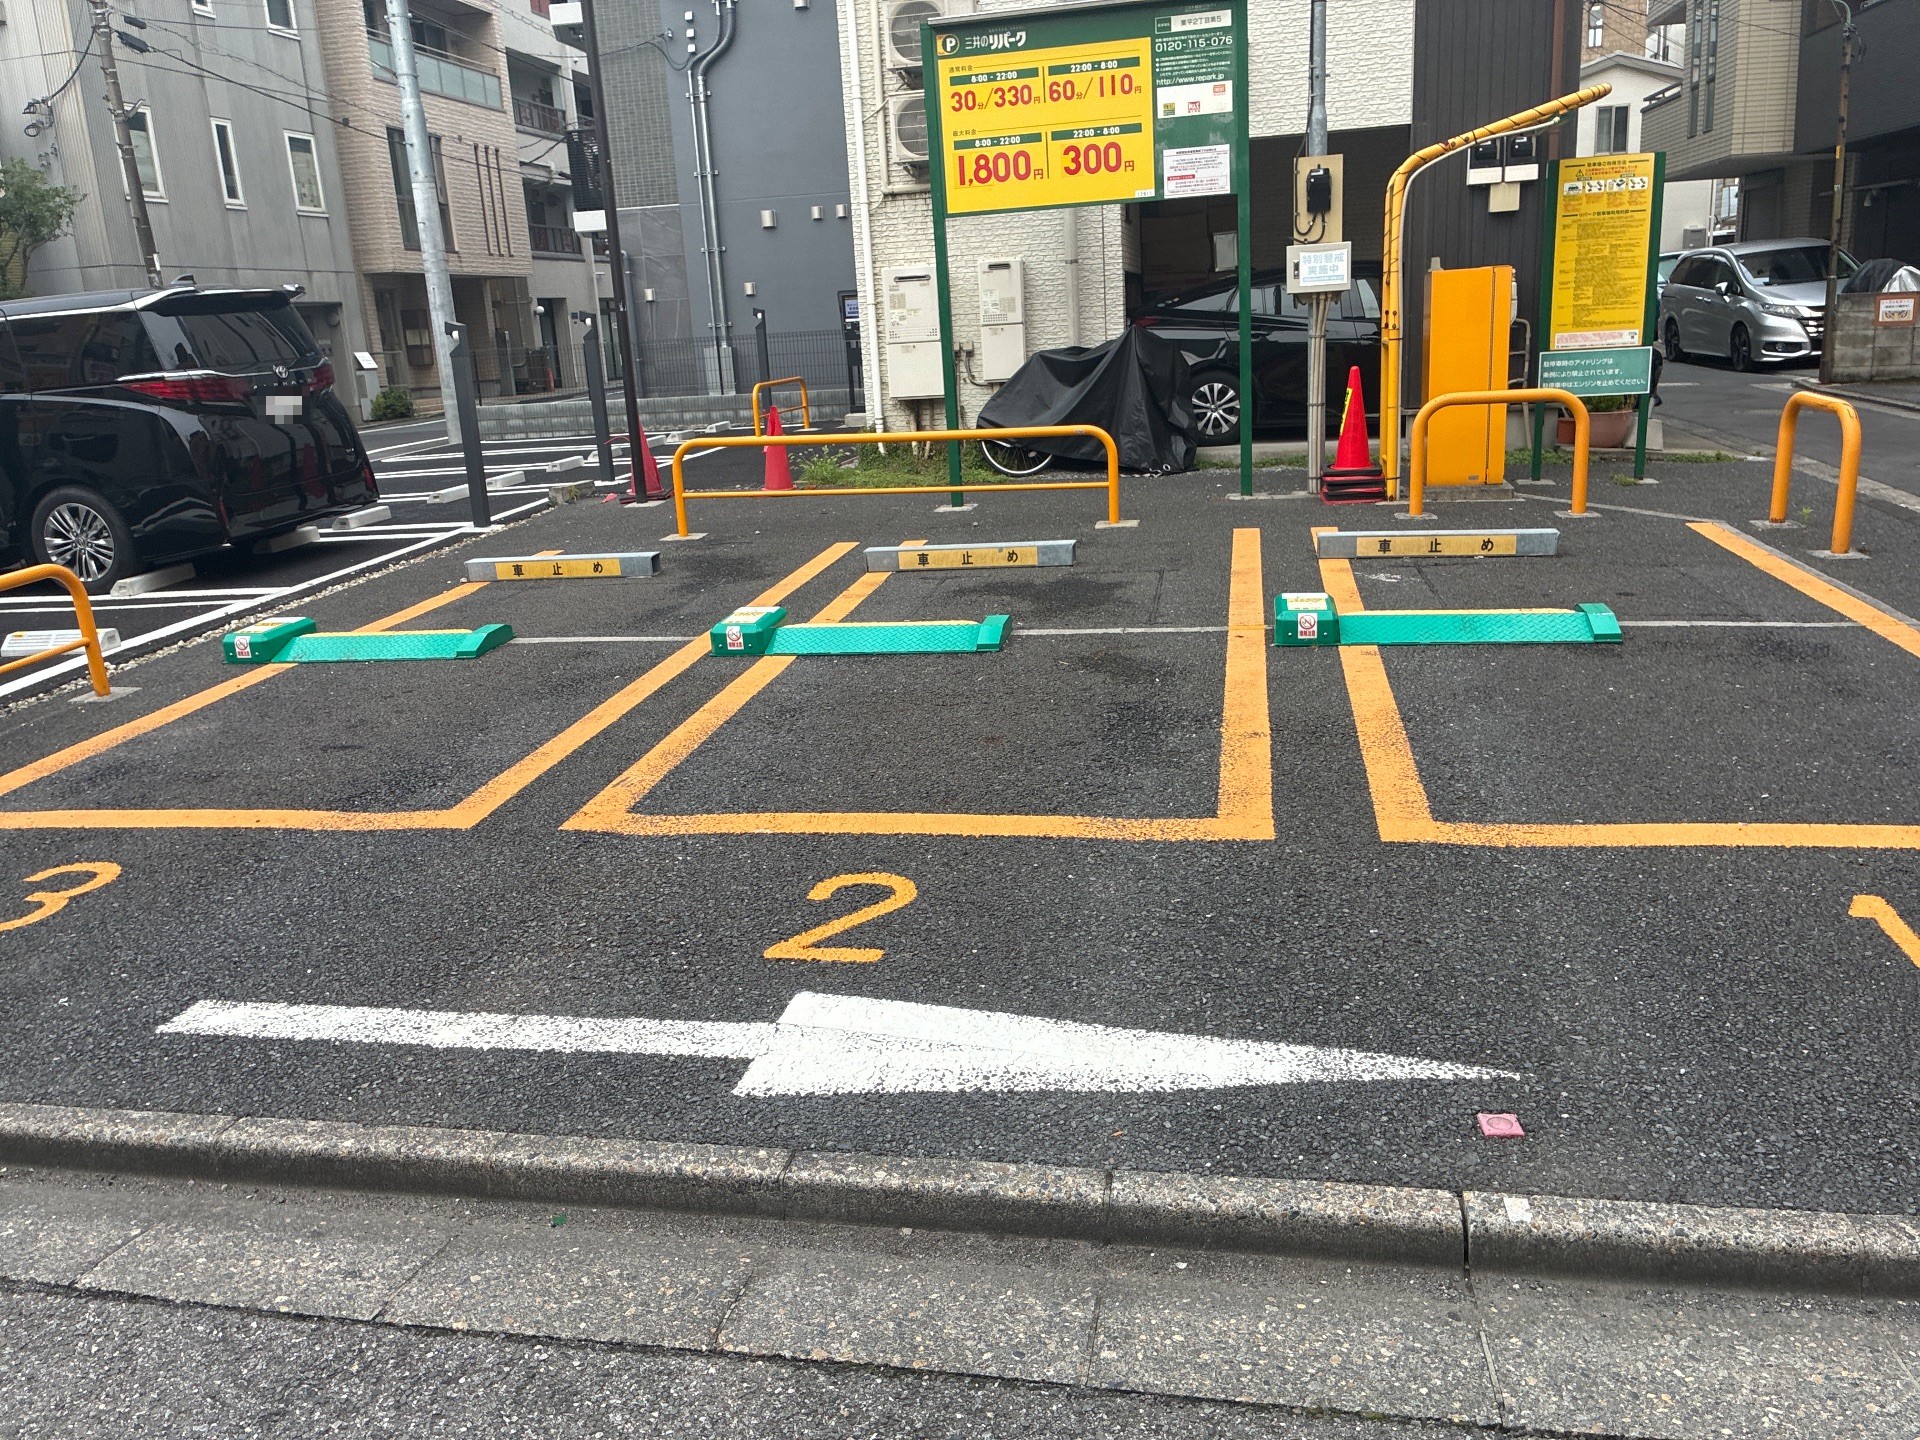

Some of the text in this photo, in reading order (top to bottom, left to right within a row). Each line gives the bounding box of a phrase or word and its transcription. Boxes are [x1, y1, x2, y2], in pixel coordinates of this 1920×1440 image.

[965, 31, 1026, 50] 三井のリパーク
[1155, 36, 1233, 52] 0120-115-076
[949, 65, 973, 73] 通常料金
[1070, 63, 1092, 73] 22:00
[1100, 60, 1118, 69] 8:00
[971, 74, 988, 83] 8:00
[996, 71, 1018, 81] 22:00
[1156, 73, 1225, 86] http://www.repark.jp
[952, 128, 977, 137] 最大料金
[1073, 129, 1095, 138] 22:00
[1102, 126, 1120, 135] 8:00
[974, 138, 992, 147] 8:00
[999, 136, 1021, 145] 22:00
[1307, 264, 1339, 275] 実施中
[1377, 537, 1494, 554] 車止め
[917, 550, 1019, 567] 車止め
[512, 561, 604, 578] 車止め
[763, 872, 918, 963] 2
